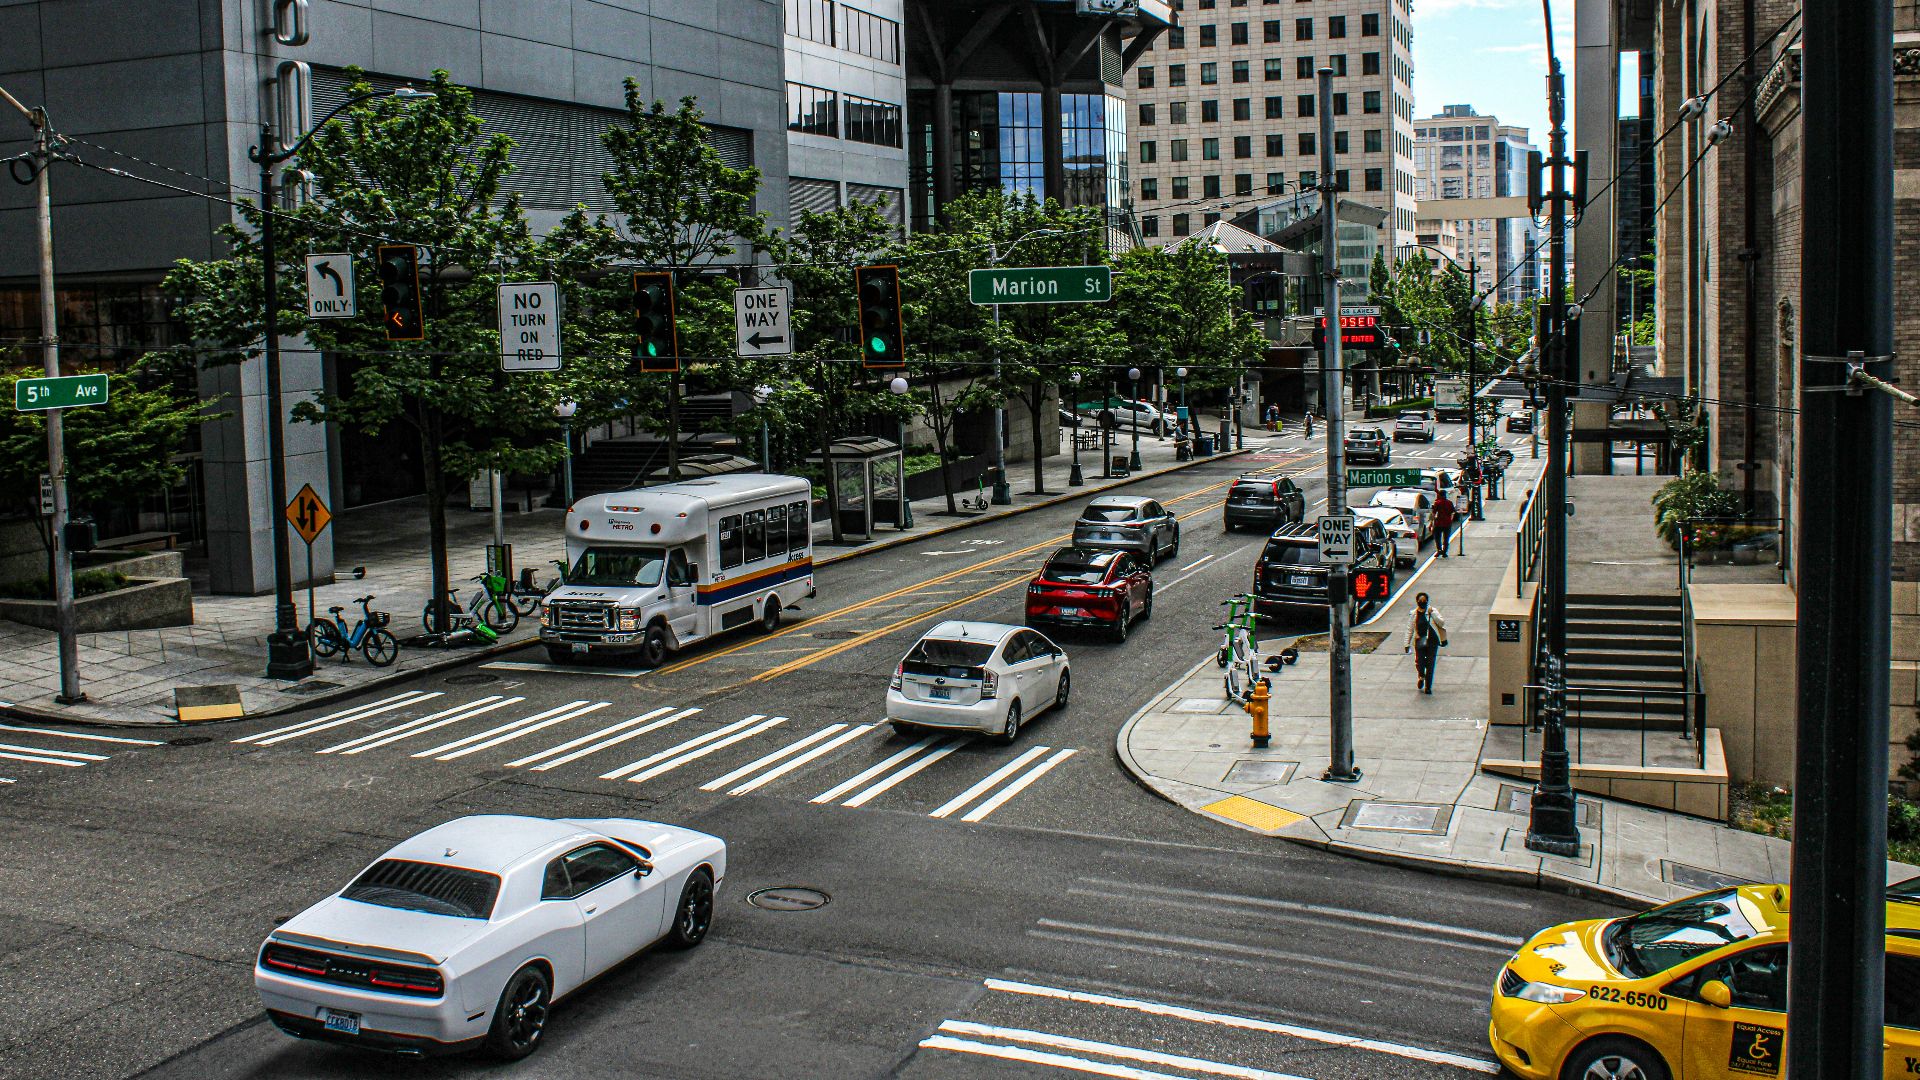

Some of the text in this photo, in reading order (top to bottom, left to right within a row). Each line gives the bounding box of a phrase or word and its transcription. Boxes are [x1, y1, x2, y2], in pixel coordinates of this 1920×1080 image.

[992, 276, 1101, 296] Marion St
[314, 299, 349, 313] ONLY
[514, 292, 542, 310] NO
[744, 293, 778, 309] ONE
[510, 313, 546, 327] TURN
[744, 311, 780, 327] WAY
[1321, 317, 1375, 328] COSED
[520, 331, 539, 344] ON
[1351, 335, 1375, 343] ENTER
[517, 348, 544, 361] RED
[26, 384, 99, 403] 5th Ave
[1349, 470, 1392, 484] Marion
[1322, 519, 1351, 532] ONE
[1322, 533, 1351, 545] WAY
[1379, 574, 1389, 596] 3
[607, 635, 625, 643] 1231
[1589, 985, 1668, 1011] 622-6500
[1736, 1023, 1781, 1036] Equal Access
[1736, 1056, 1757, 1065] Equal
